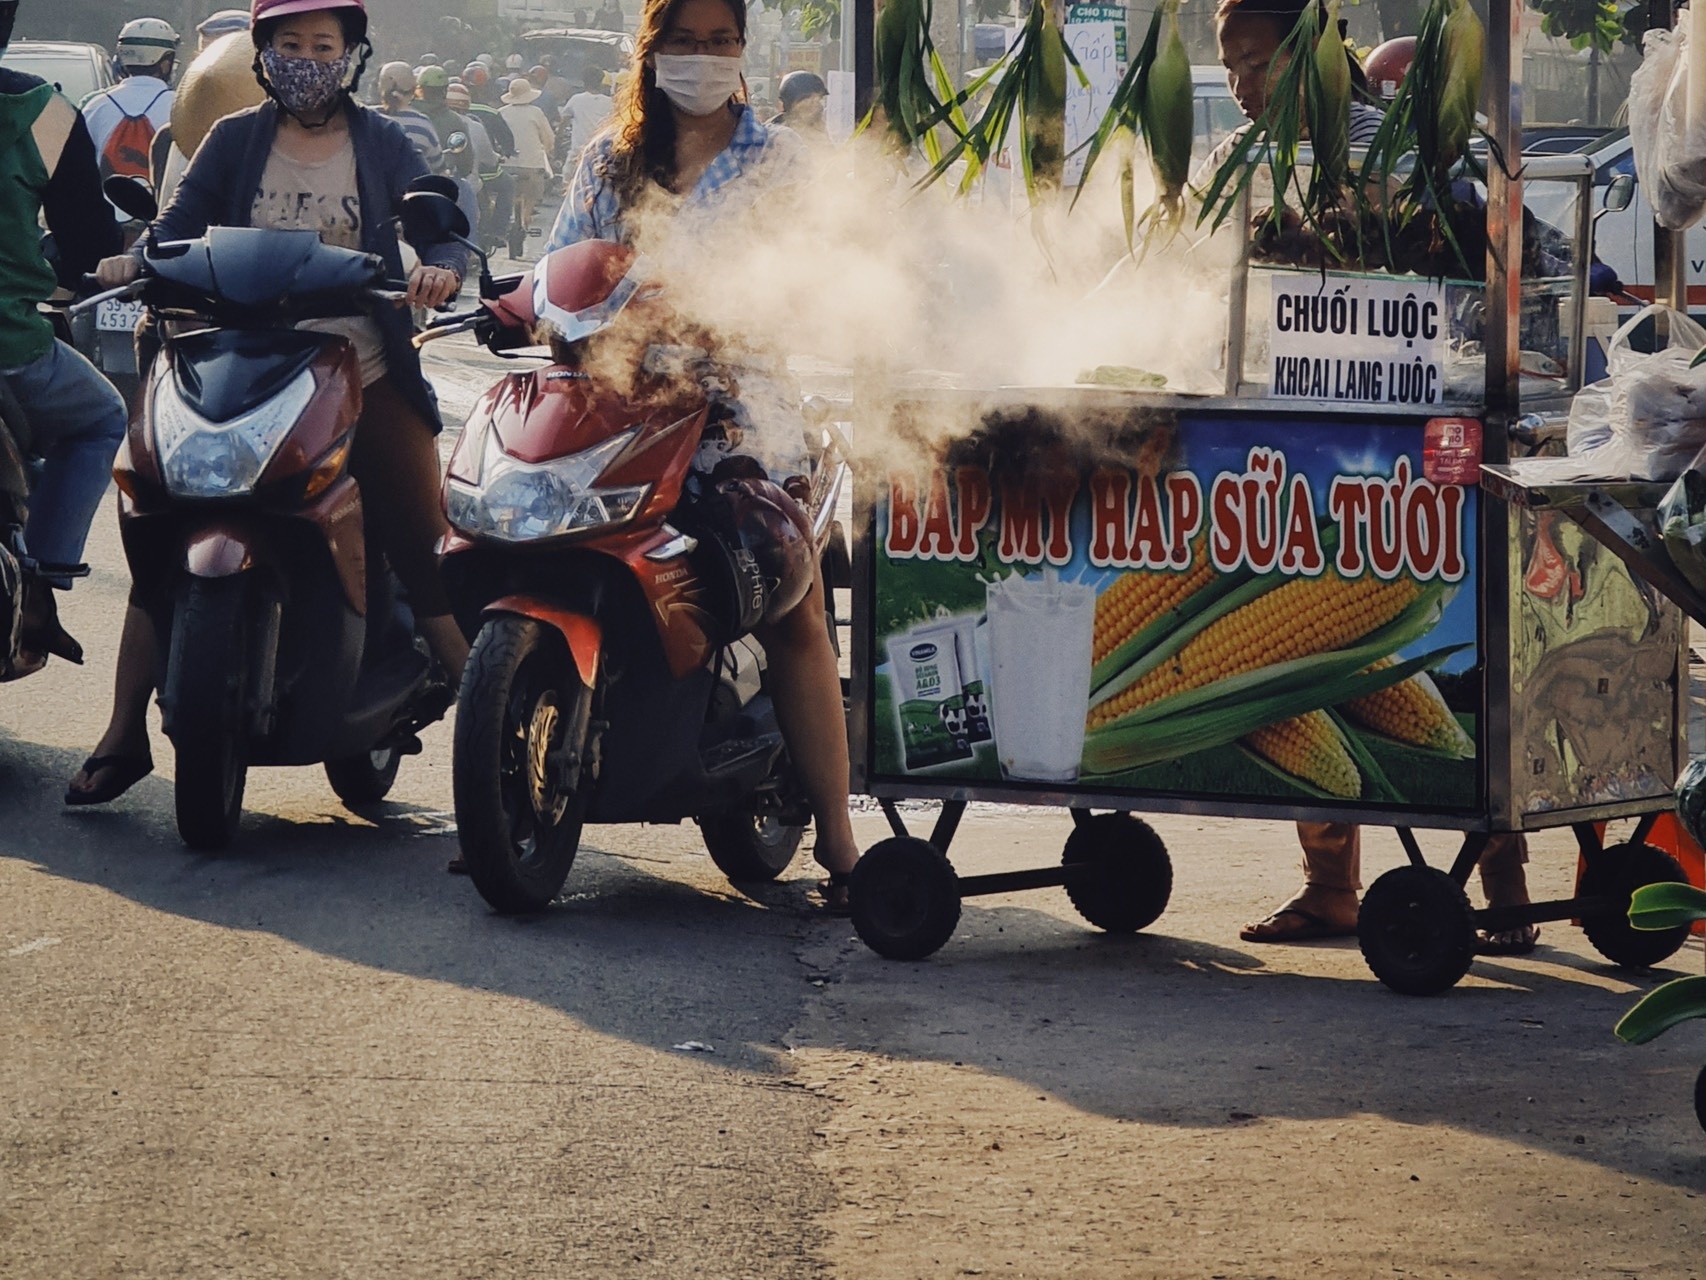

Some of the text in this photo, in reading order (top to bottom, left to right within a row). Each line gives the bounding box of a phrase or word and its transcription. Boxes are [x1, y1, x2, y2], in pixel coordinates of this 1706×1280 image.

[1077, 7, 1100, 17] CHO
[1276, 285, 1438, 348] CHUỐI LUỘC
[1274, 356, 1330, 397] KHOAI
[1334, 359, 1383, 401] LANG
[1210, 446, 1325, 576] SỮA
